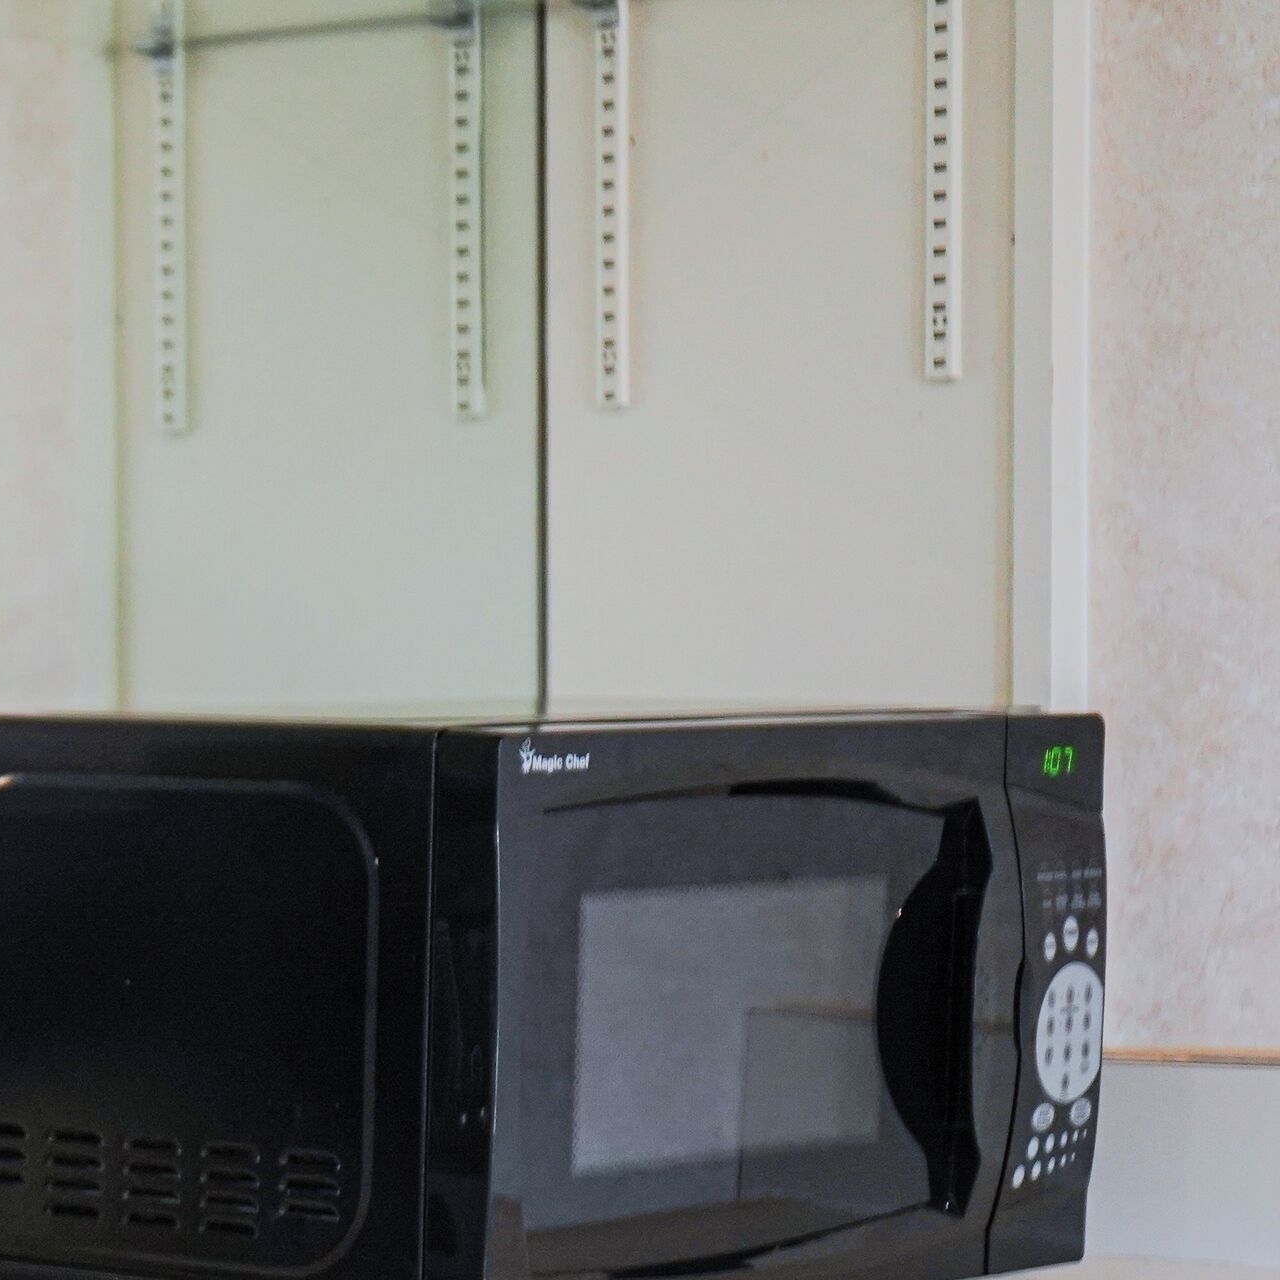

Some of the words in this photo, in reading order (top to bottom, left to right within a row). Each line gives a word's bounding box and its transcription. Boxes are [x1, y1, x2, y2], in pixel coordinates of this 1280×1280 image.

[532, 754, 563, 774] Magic
[565, 752, 590, 770] Chef
[1043, 746, 1073, 776] 1:07
